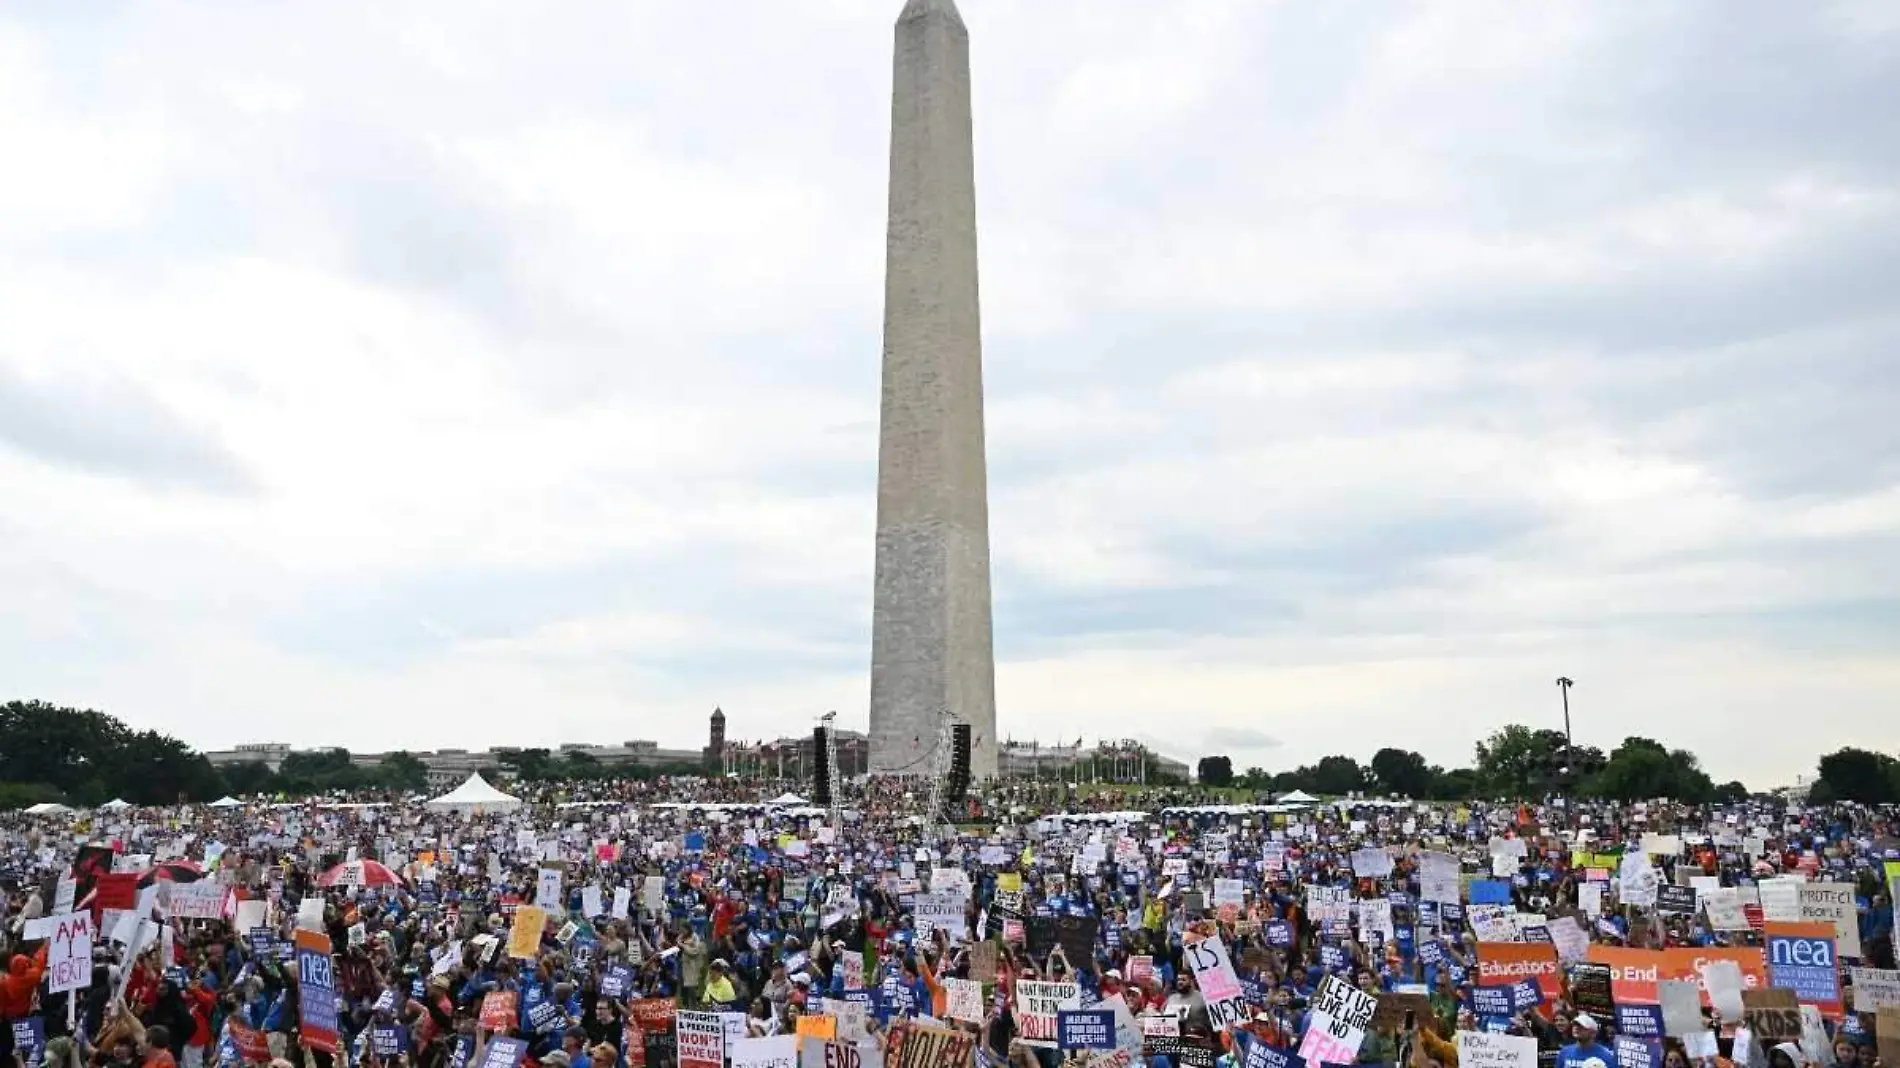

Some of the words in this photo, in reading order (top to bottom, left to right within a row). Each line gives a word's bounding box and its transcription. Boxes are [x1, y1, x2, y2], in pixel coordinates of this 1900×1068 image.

[1801, 890, 1850, 904] PROTECT
[56, 919, 88, 943] AM
[68, 939, 72, 957] I
[1188, 938, 1218, 971] IS
[1772, 939, 1832, 966] nea
[302, 953, 331, 988] nea
[1480, 960, 1556, 976] Educators
[1624, 965, 1657, 981] End
[1326, 976, 1355, 1001] LET
[1355, 993, 1377, 1016] US
[680, 1012, 719, 1022] THOUGHTS
[1065, 1015, 1101, 1024] MARCH
[1318, 995, 1344, 1020] LIVE
[1344, 1008, 1370, 1032] WITH
[1622, 1008, 1649, 1016] MARCH
[1328, 1020, 1349, 1038] NO
[1750, 1009, 1800, 1036] KIDS
[680, 1033, 720, 1047] WON'T
[680, 1046, 705, 1058] SAVE
[707, 1048, 720, 1059] US
[825, 1041, 860, 1068] END
[1249, 1041, 1288, 1066] MARCH
